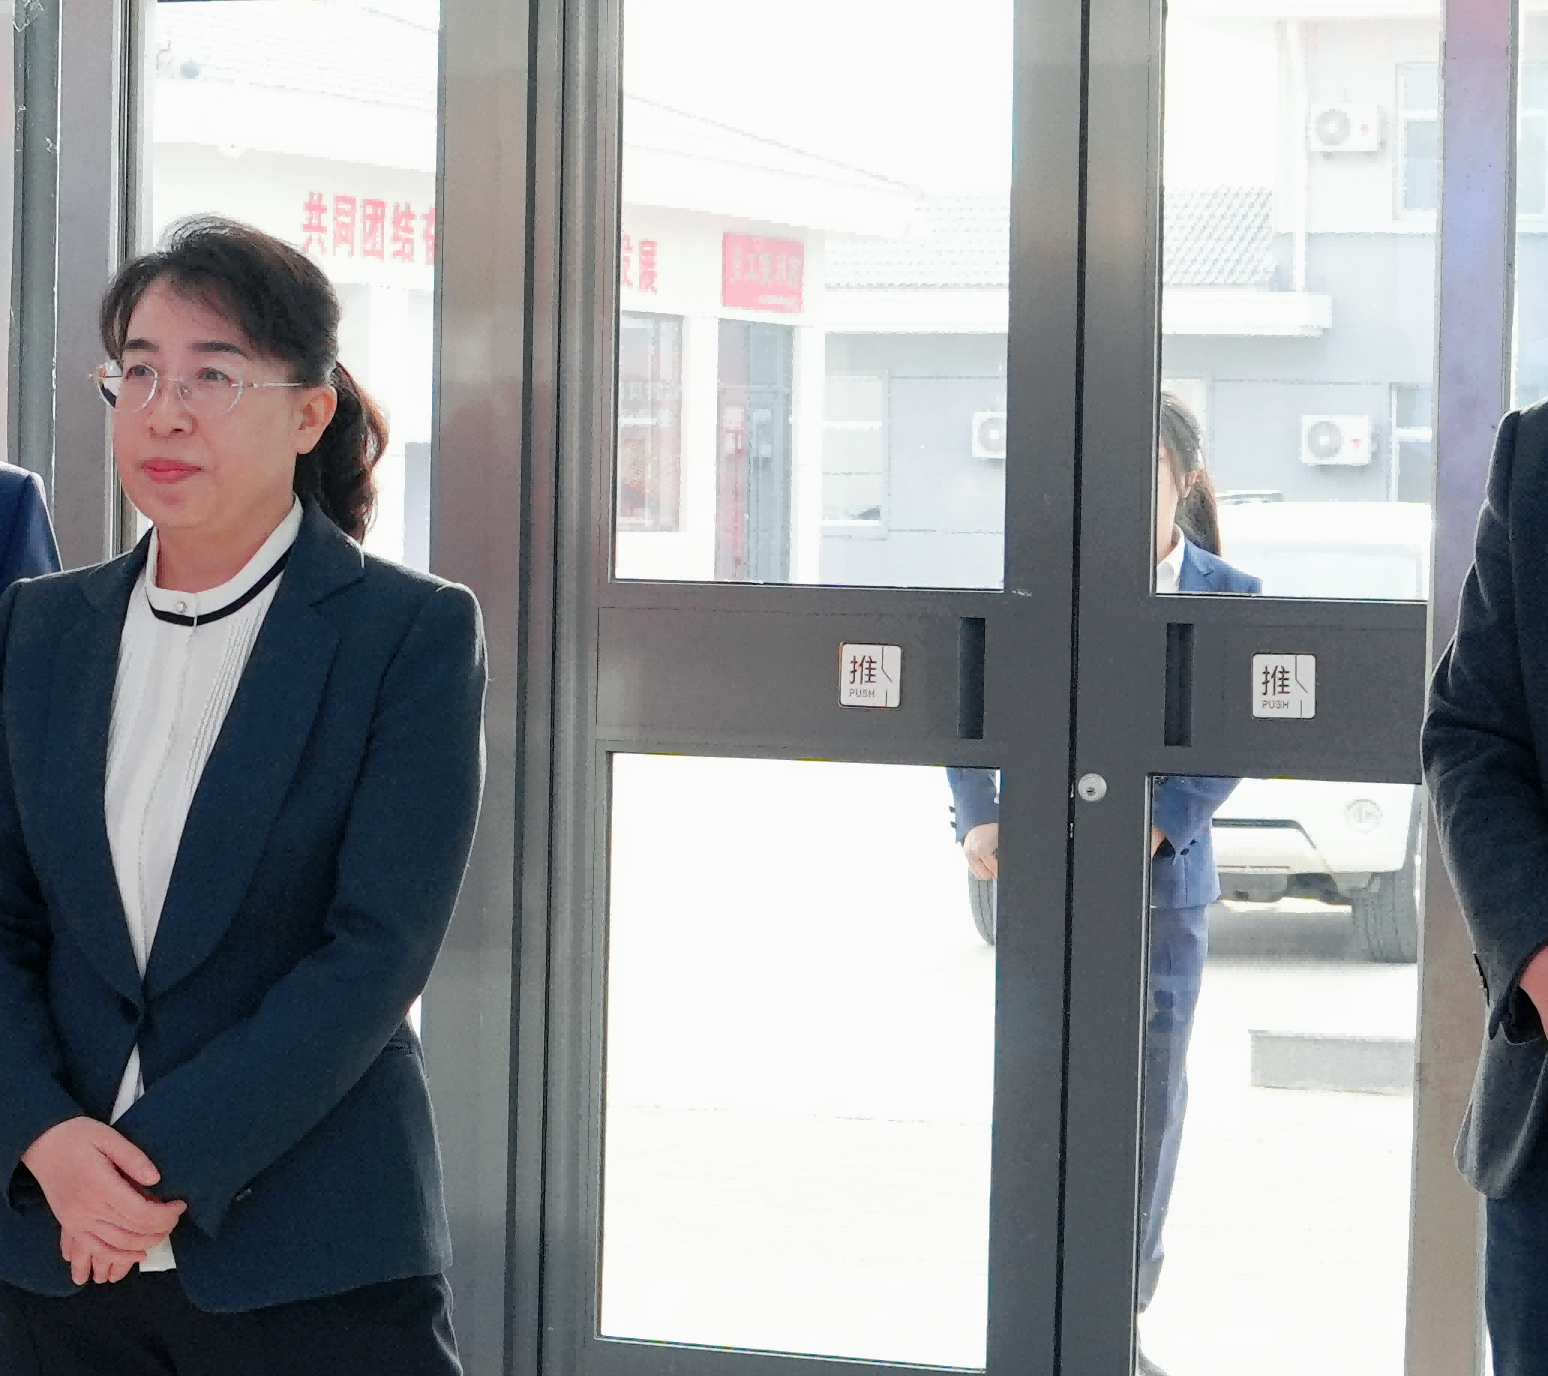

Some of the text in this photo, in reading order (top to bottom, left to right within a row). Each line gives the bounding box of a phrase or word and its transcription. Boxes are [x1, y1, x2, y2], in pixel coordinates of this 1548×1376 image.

[849, 655, 877, 685] 推
[1261, 665, 1291, 696] 推
[848, 688, 876, 698] PUSH
[1261, 700, 1291, 710] PUSH
